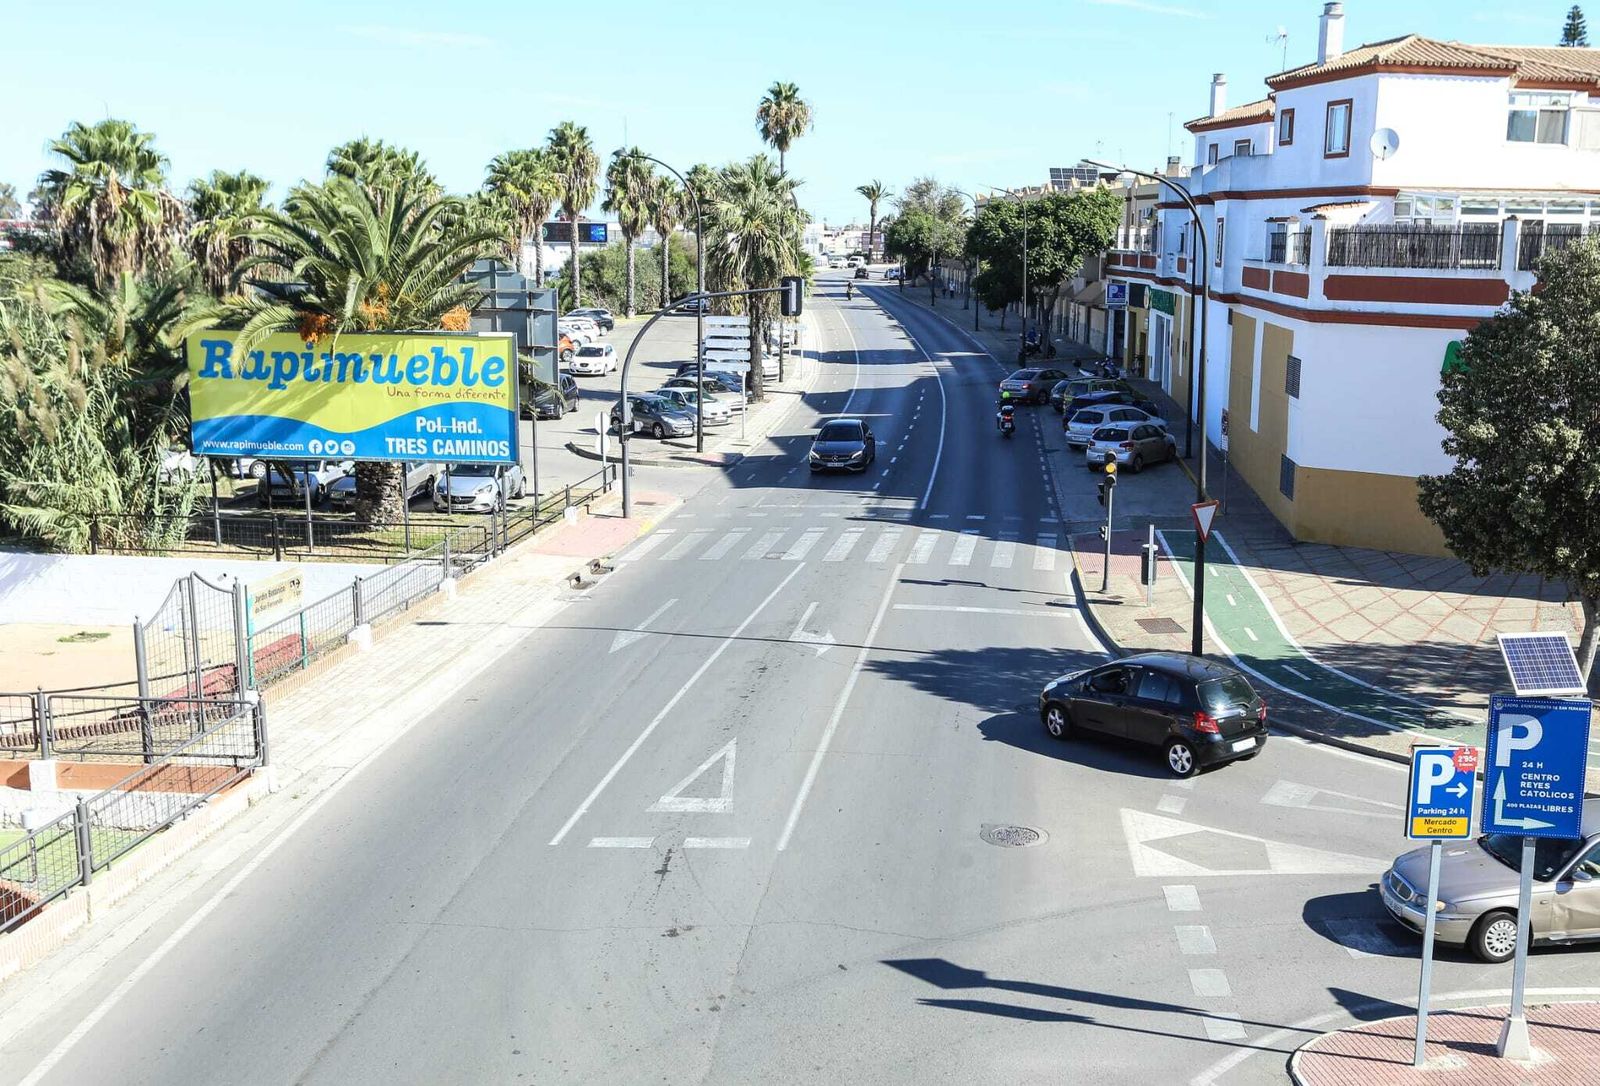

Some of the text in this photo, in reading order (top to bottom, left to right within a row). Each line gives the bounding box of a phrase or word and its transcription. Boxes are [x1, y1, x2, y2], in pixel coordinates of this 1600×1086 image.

[198, 339, 506, 390] Rapimueble
[387, 386, 506, 400] Una forma diferente
[415, 416, 483, 434] Pol. Ind.
[202, 439, 304, 451] www.rapimueble.com
[385, 437, 510, 457] TRES CAMINOS
[1495, 713, 1543, 767] P
[1536, 761, 1544, 769] H
[1416, 754, 1456, 805] P
[1521, 772, 1560, 782] CENTRO
[1520, 781, 1551, 790] REYES
[1519, 789, 1575, 800] CATOLICOS
[1417, 807, 1466, 816] Parking 24 h
[1541, 804, 1574, 814] LIBRES
[1424, 818, 1457, 826] Mercado
[1427, 826, 1453, 834] Centro
